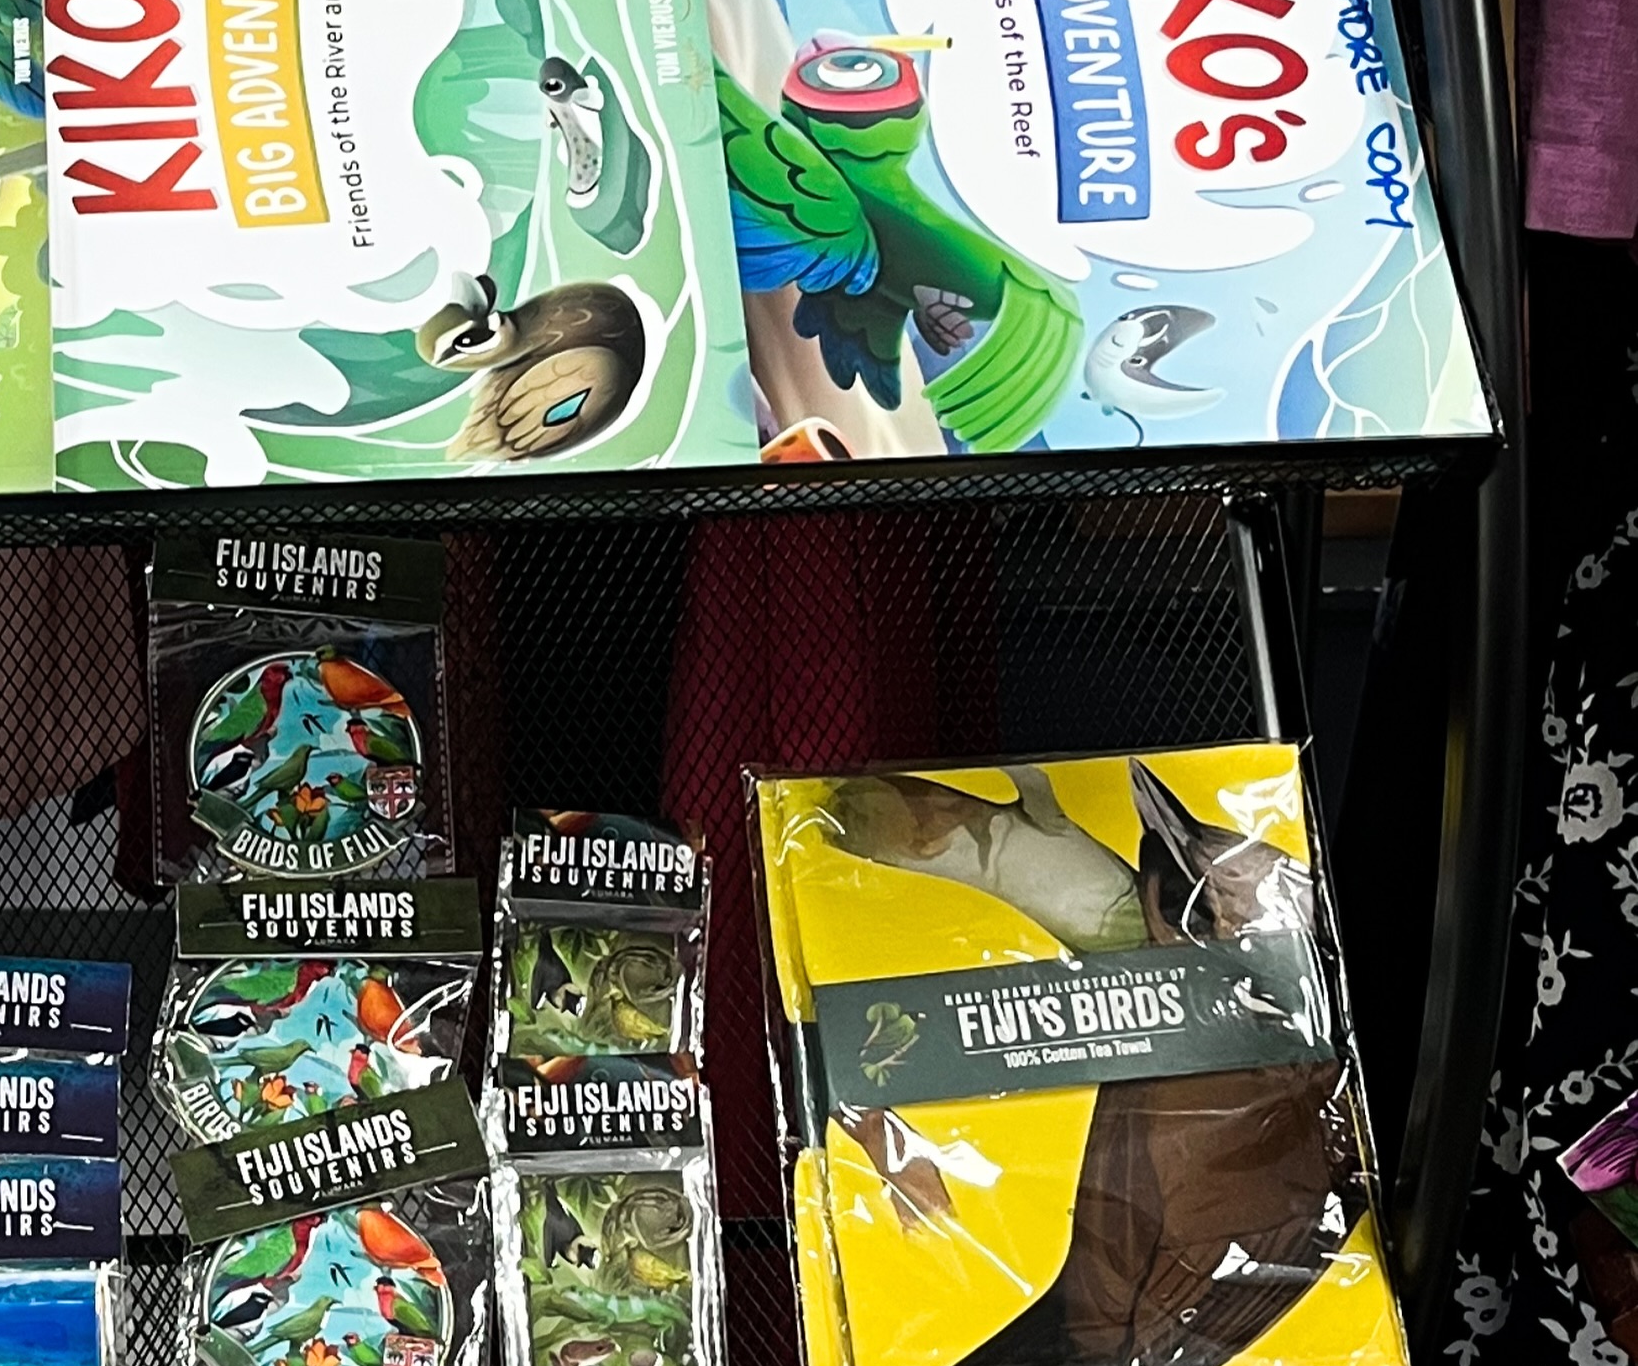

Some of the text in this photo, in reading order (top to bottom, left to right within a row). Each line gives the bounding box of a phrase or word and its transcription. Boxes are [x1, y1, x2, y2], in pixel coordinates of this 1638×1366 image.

[1000, 16, 1025, 40] of
[323, 24, 344, 78] River
[655, 52, 682, 85] TOM
[1004, 50, 1029, 93] the
[328, 86, 349, 128] the
[333, 131, 356, 154] of
[1010, 102, 1041, 158] Reef
[236, 142, 306, 216] BIG
[340, 159, 374, 247] Friends
[216, 538, 382, 580] FIJI ISLANDS
[216, 568, 377, 602] SOUVENIRS
[232, 824, 391, 870] BIRDS OF FIJI
[528, 834, 693, 875] FIJI ISLANDS
[532, 866, 684, 893] SOUVENIRS
[242, 892, 415, 920] FIJI ISLANDS
[246, 919, 413, 939] SOUVENIRS
[957, 982, 1185, 1047] FIJI'S BIRDS
[1004, 1049, 1041, 1069] 100%
[1087, 1042, 1113, 1058] Tea
[1114, 1038, 1153, 1056] Towel
[518, 1080, 688, 1117] FIJI ISLANDS
[526, 1112, 683, 1136] SOUVENIRS
[236, 1109, 412, 1184] FIJI ISLANDS
[249, 1142, 416, 1206] SOUVENIRS
